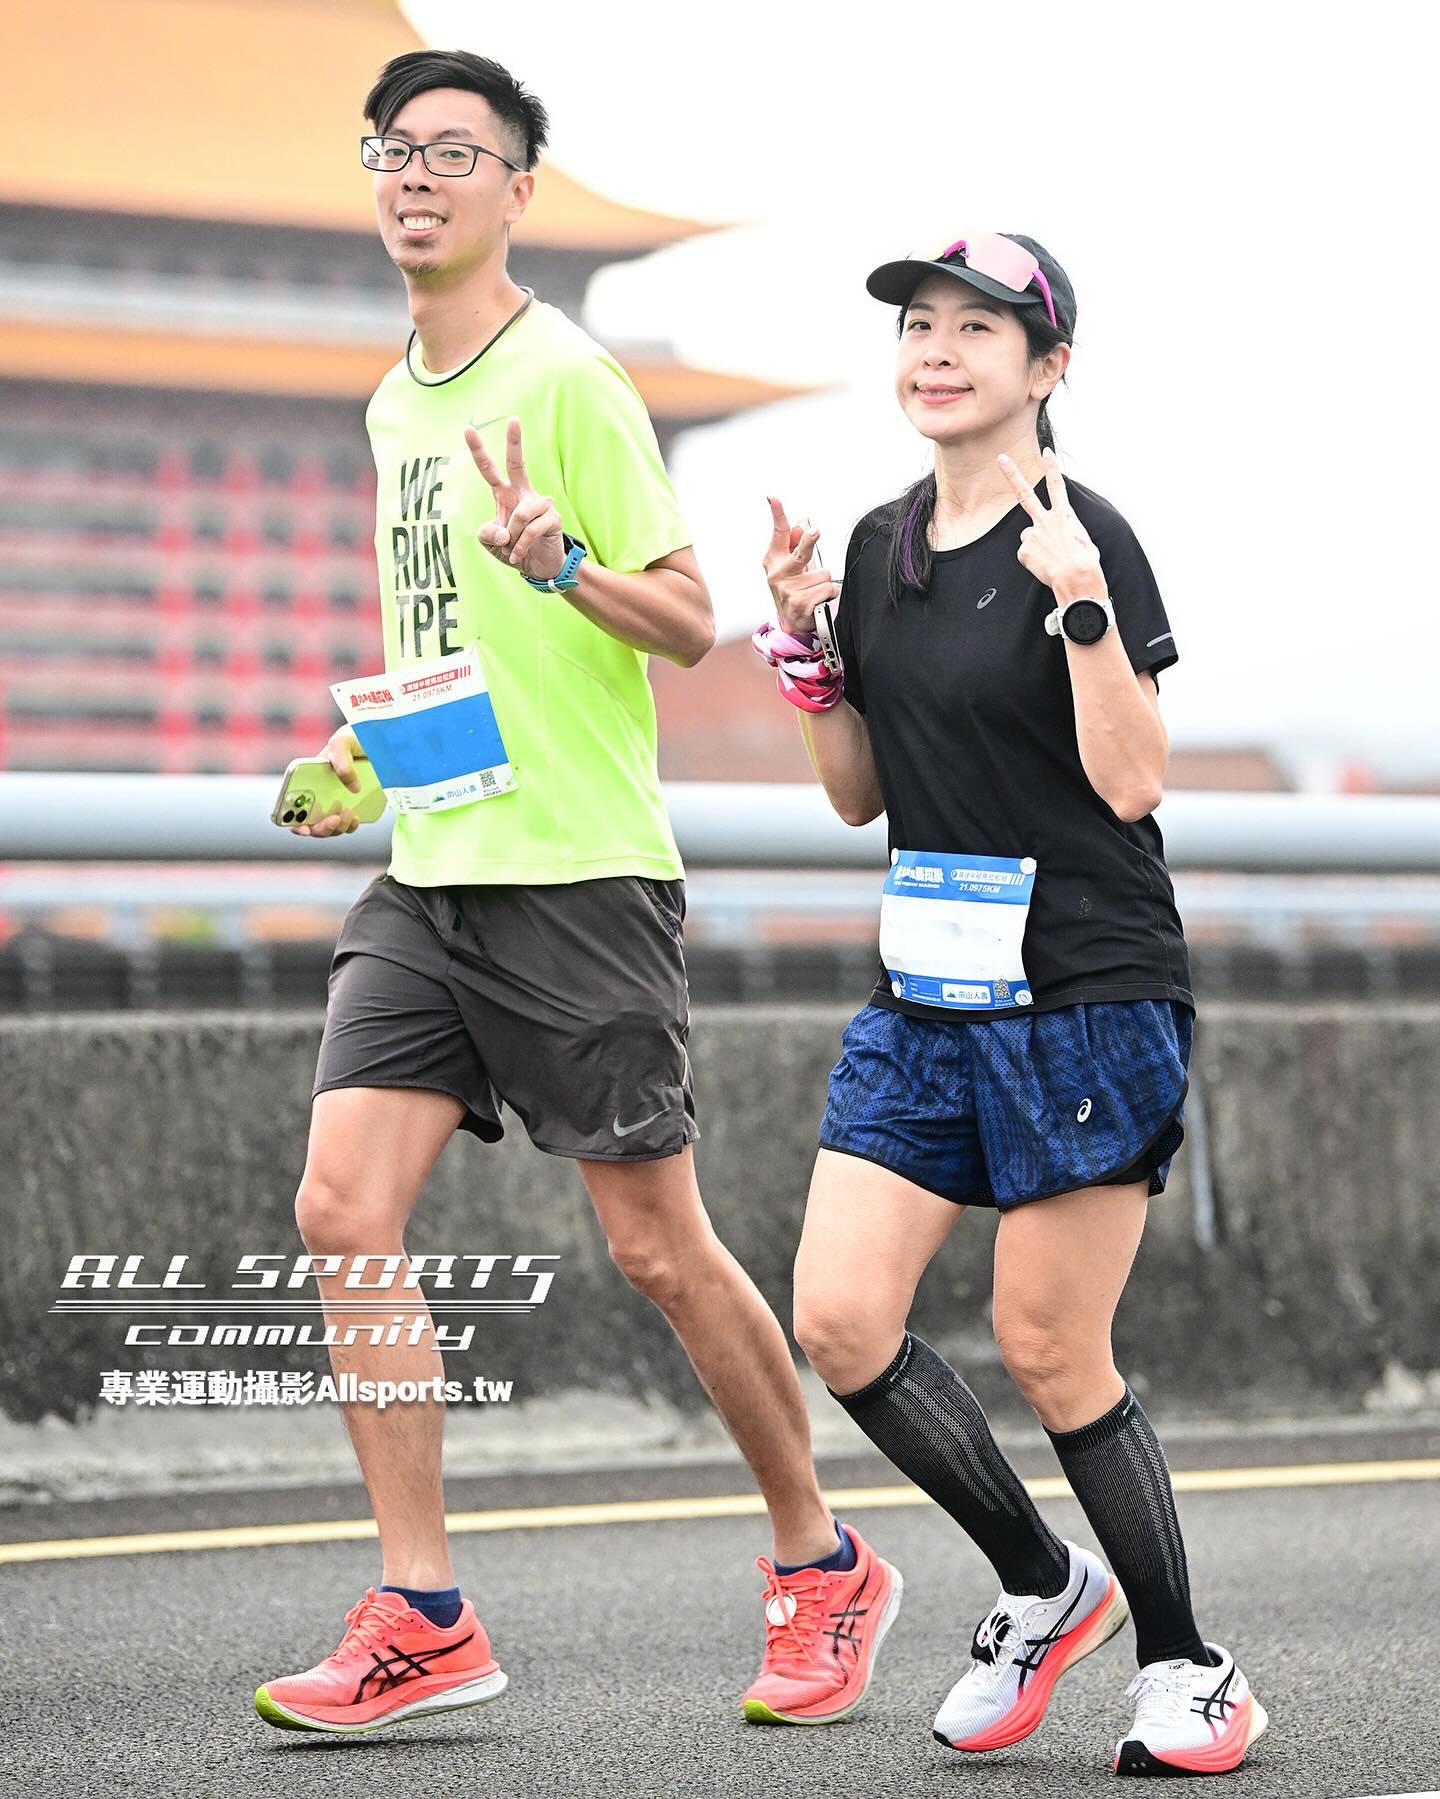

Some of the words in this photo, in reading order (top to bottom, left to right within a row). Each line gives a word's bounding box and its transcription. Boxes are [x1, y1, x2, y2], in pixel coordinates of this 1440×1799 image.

[400, 456, 450, 521] WE
[392, 524, 456, 590] RUN
[396, 593, 464, 658] TPE
[412, 684, 453, 702] 21.0975KM
[446, 784, 478, 799] 南山人壽
[959, 883, 1001, 894] 21.0975KM
